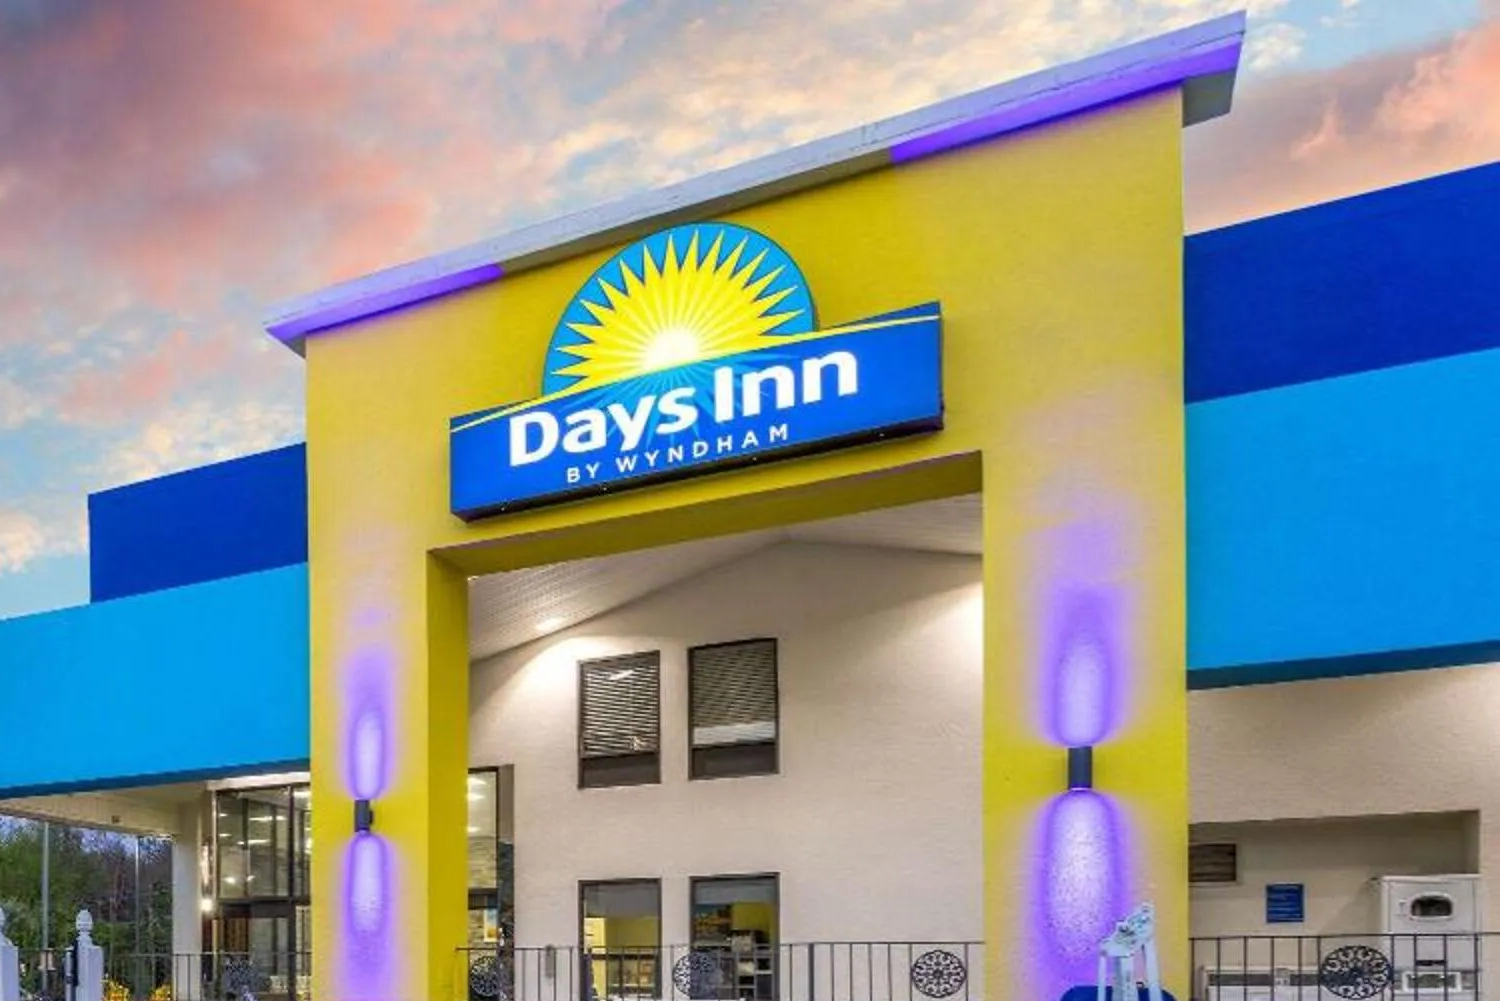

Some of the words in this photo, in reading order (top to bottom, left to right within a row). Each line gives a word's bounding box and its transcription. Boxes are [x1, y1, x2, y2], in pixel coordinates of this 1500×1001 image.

[509, 387, 699, 467] Days
[714, 351, 858, 423] Inn
[566, 463, 600, 483] BY
[615, 423, 789, 473] WYNDHAM
